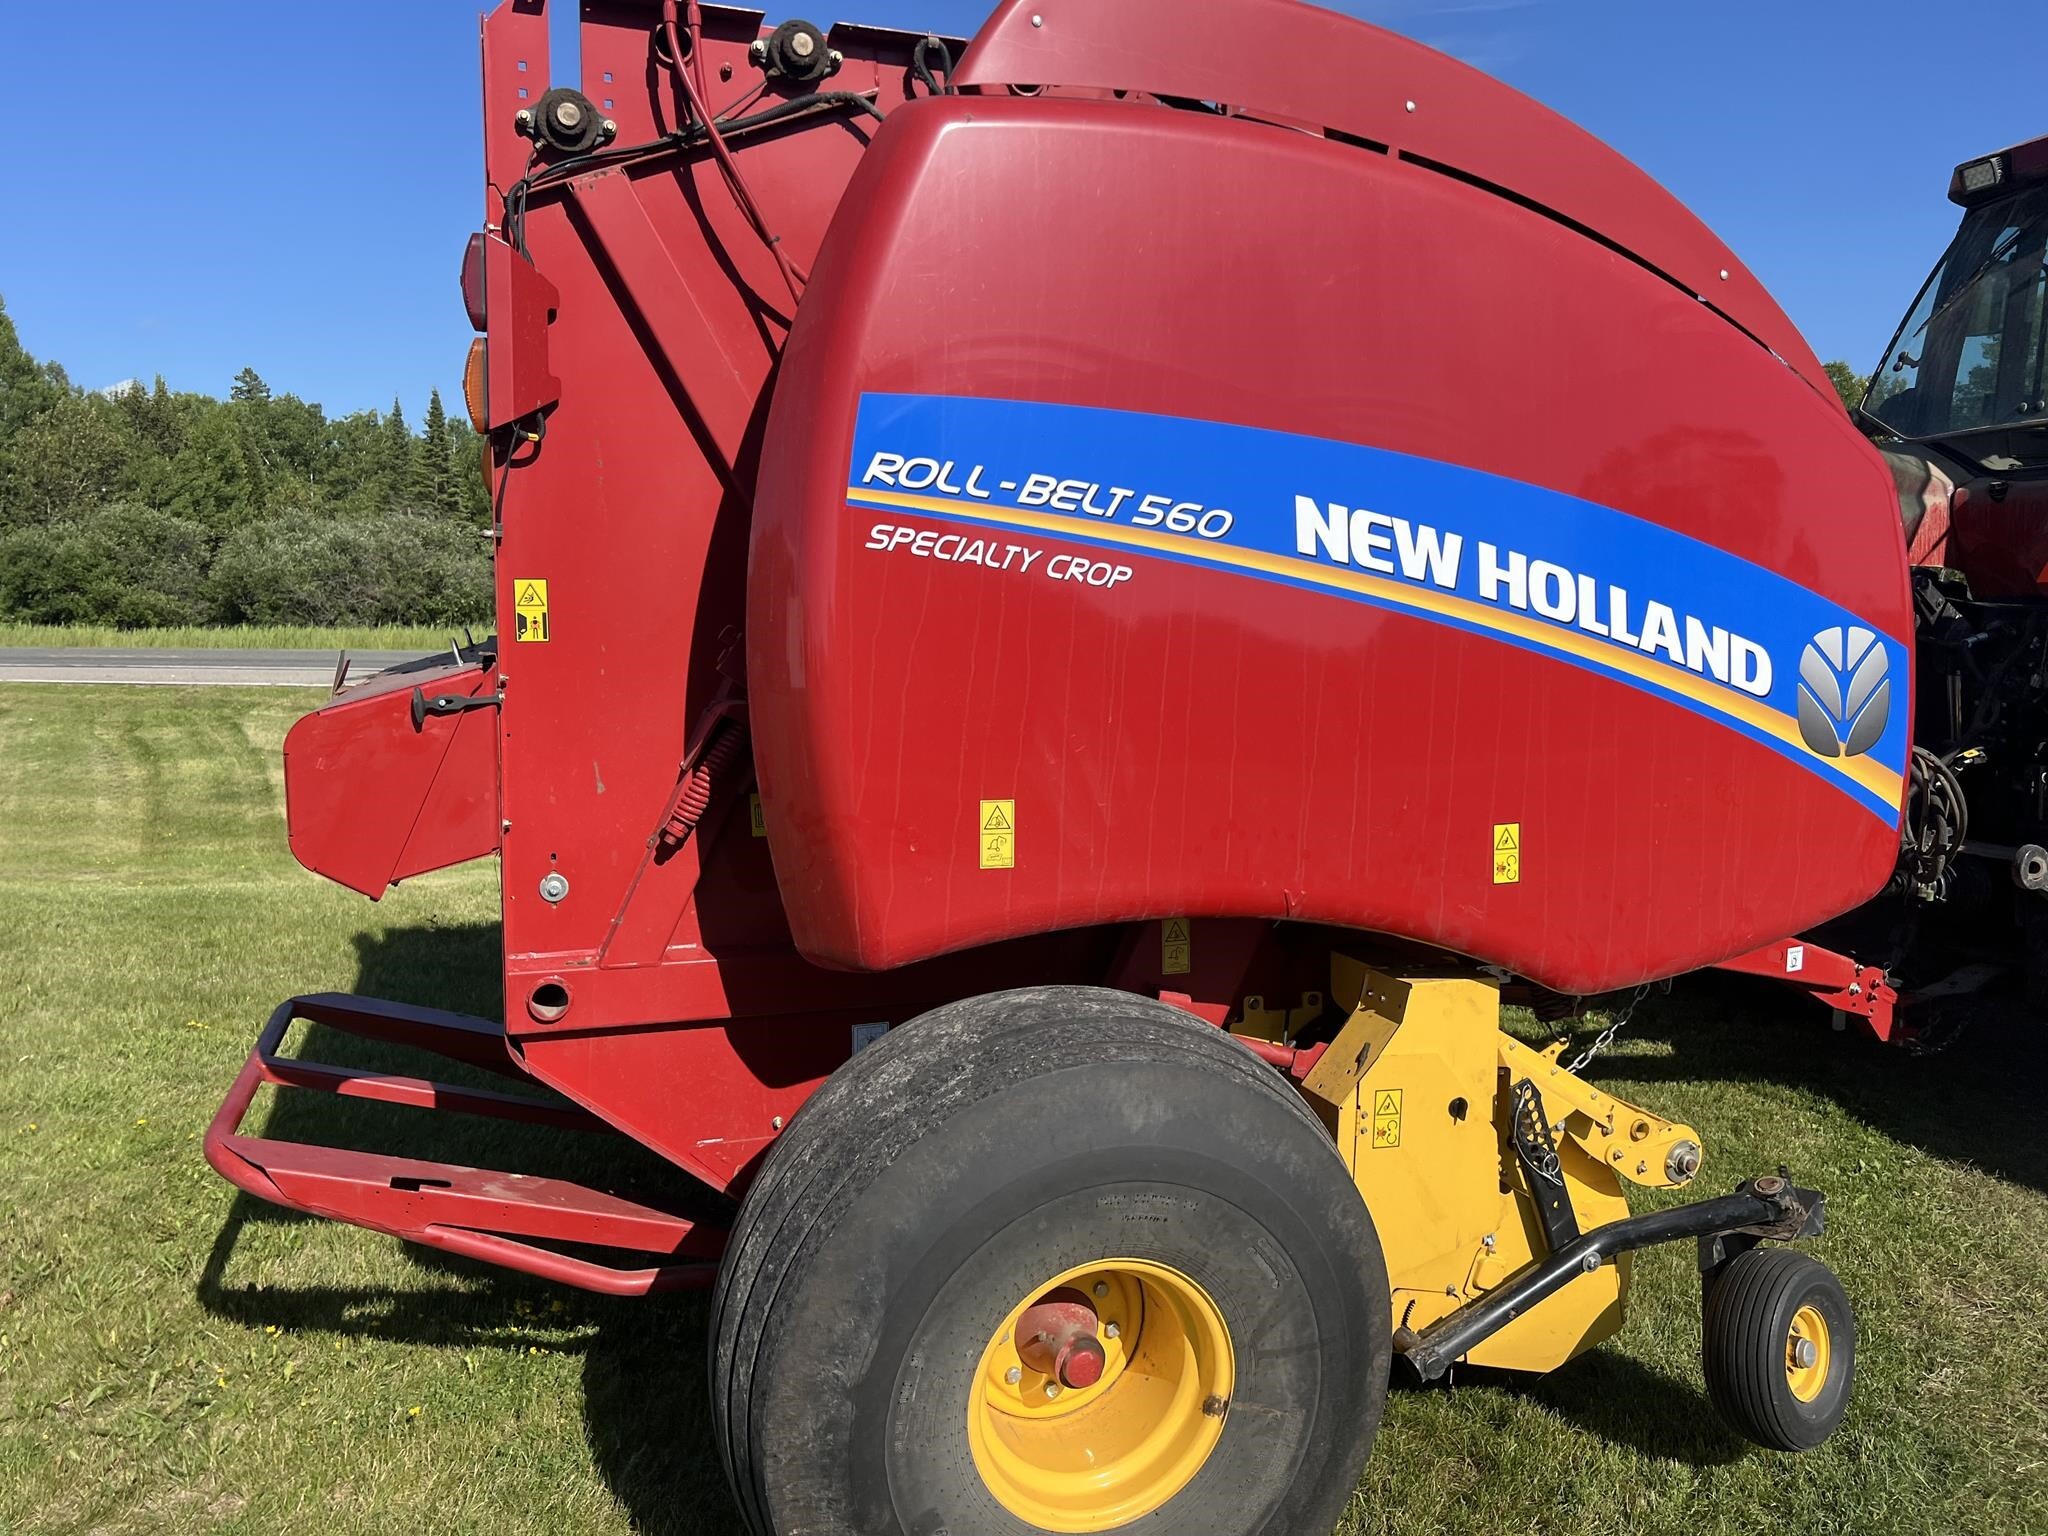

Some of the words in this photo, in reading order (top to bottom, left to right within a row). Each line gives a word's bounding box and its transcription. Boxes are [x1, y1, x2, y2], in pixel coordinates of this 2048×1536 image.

[1131, 494, 1234, 539] 560
[865, 523, 1043, 575] SPECIALTY
[1046, 554, 1133, 590] CROP
[1295, 494, 1463, 590] NEW
[1478, 541, 1773, 697] HOLLAND
